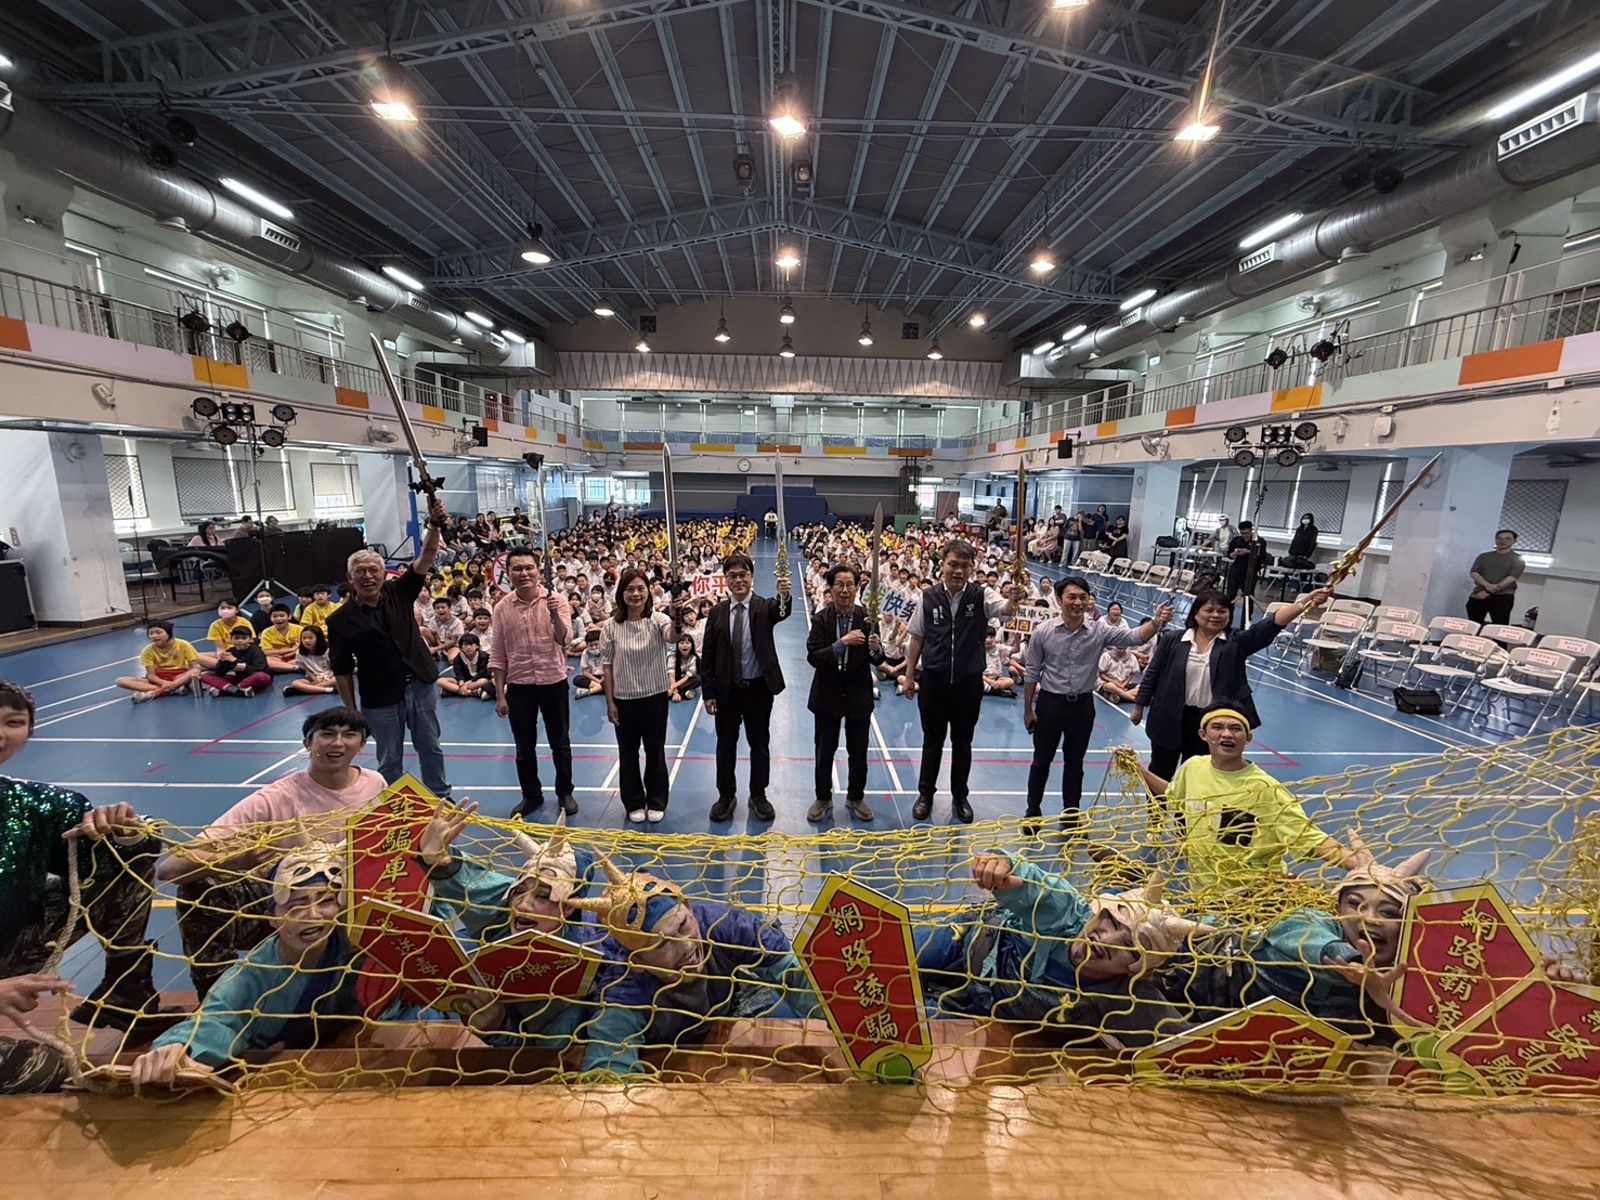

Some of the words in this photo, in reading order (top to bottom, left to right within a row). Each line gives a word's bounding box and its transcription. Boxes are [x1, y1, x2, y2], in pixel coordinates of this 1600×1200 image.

[831, 902, 899, 1043] 網路誘騙
[1428, 906, 1498, 1032] 網路霸凌
